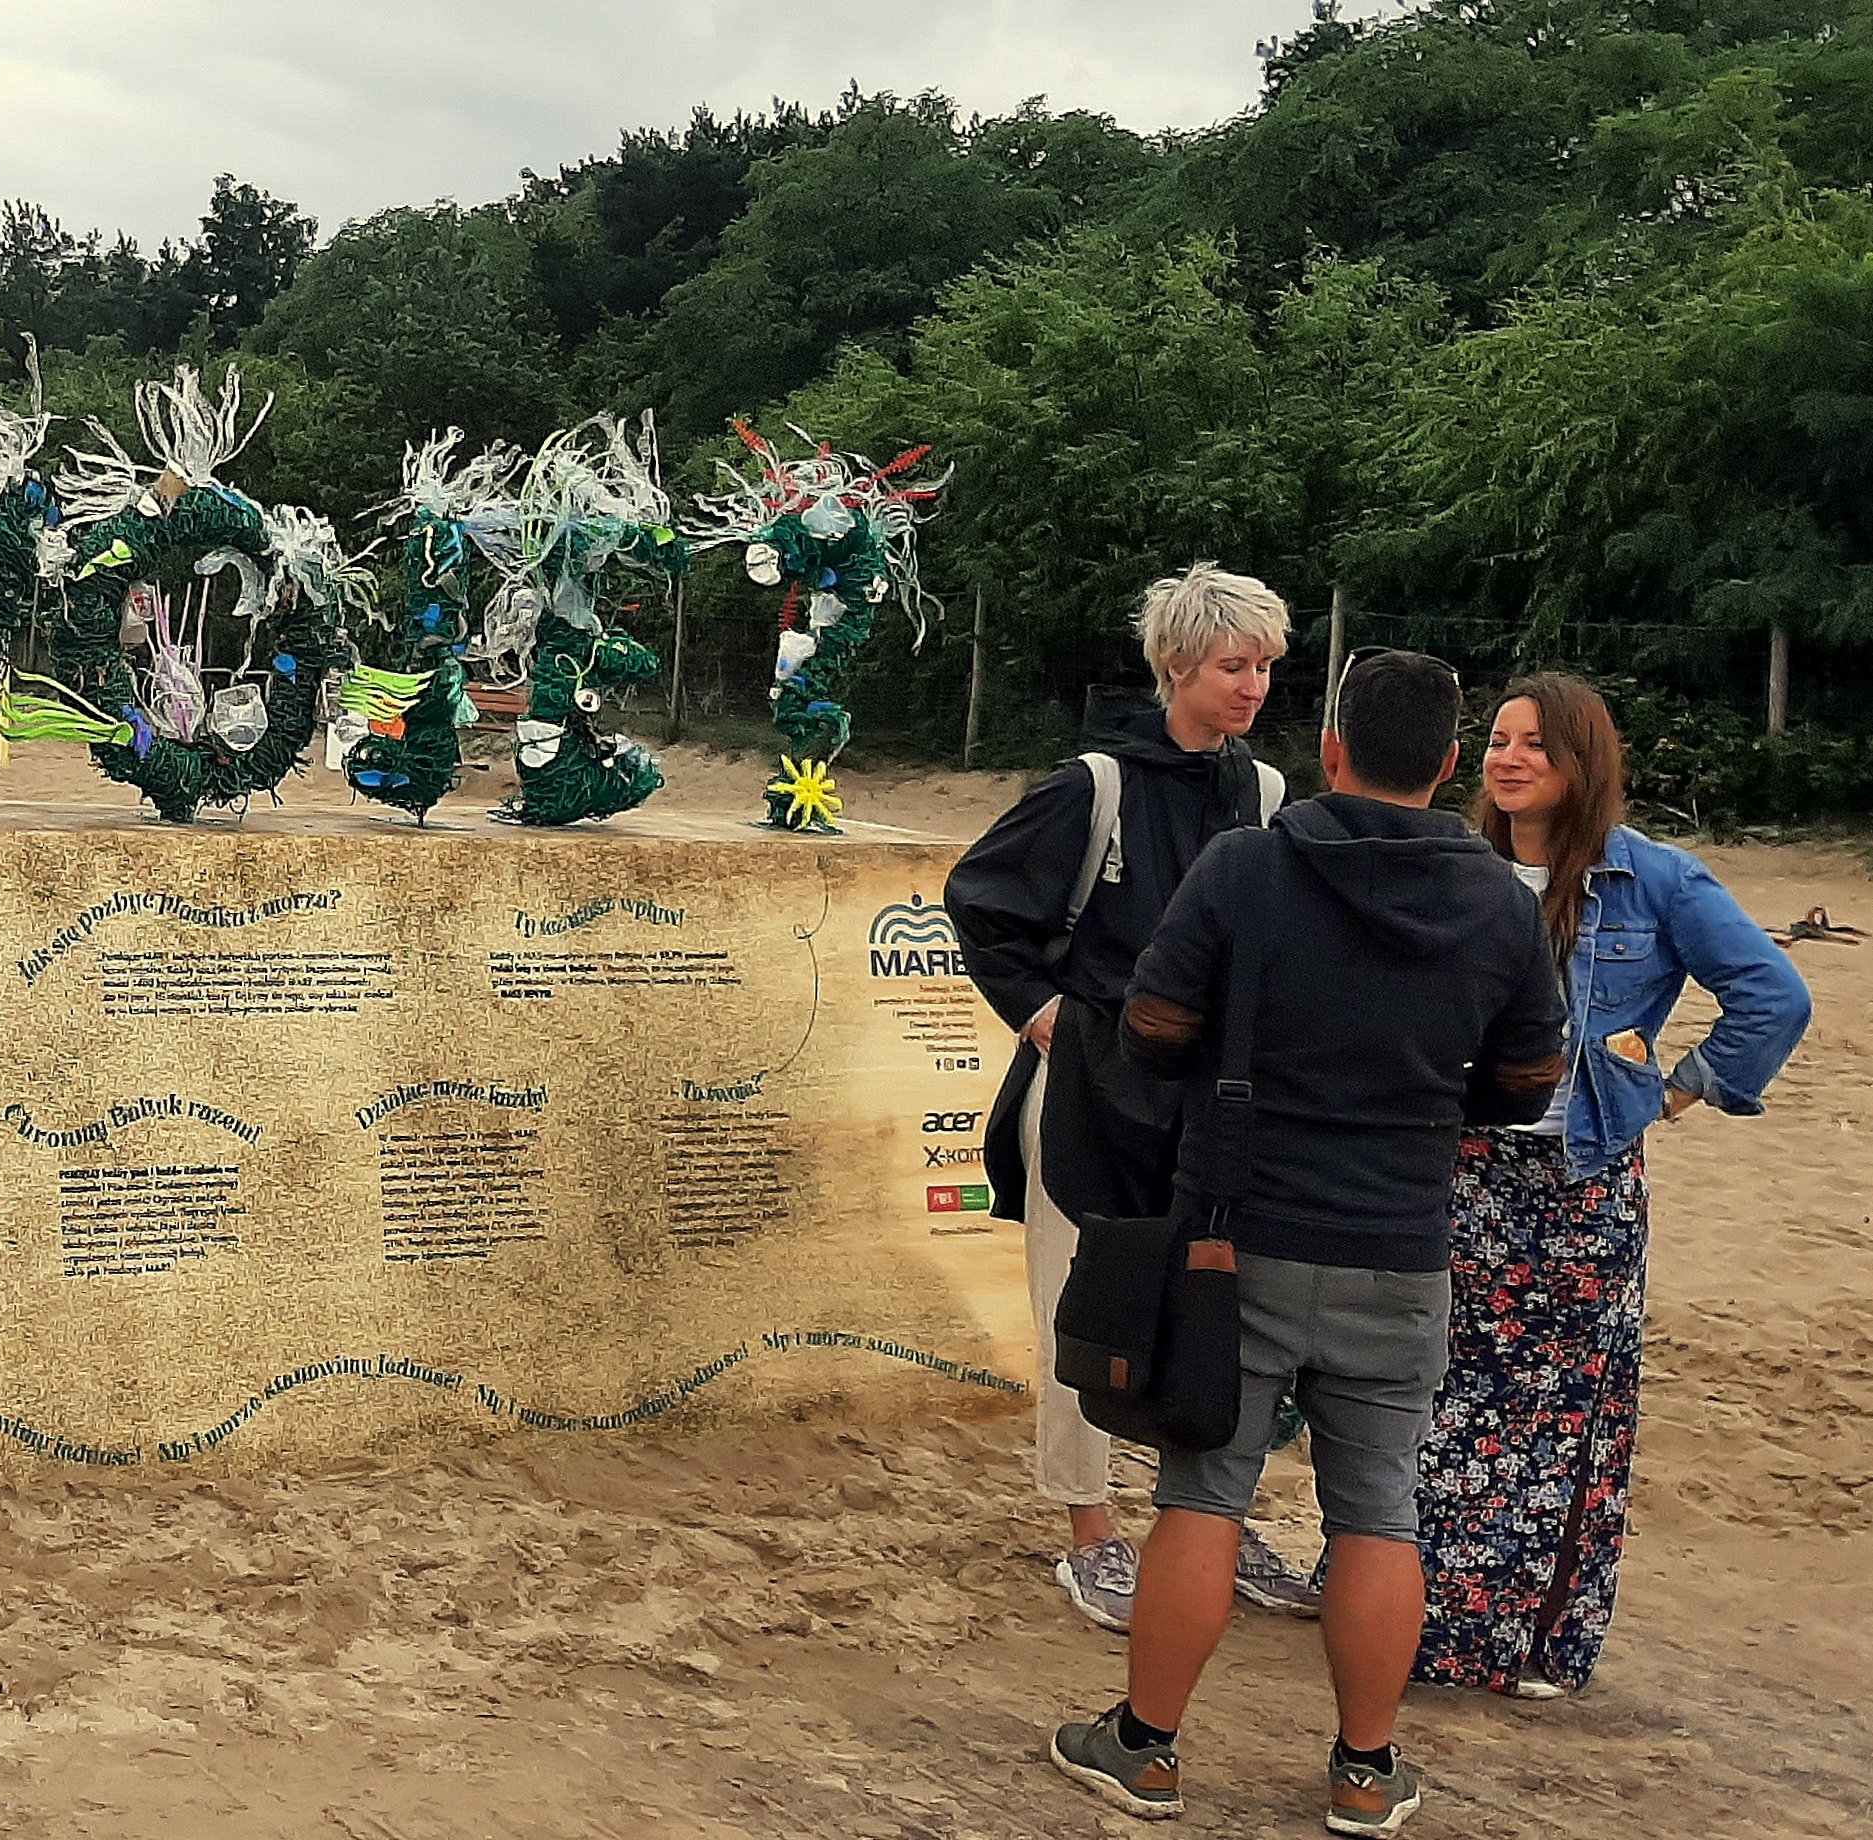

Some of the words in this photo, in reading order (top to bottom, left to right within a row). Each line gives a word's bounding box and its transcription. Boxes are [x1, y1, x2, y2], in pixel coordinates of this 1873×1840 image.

[16, 947, 54, 987] Jak
[261, 888, 343, 920] morza?
[187, 1100, 264, 1147] razem!
[921, 1111, 983, 1133] acer
